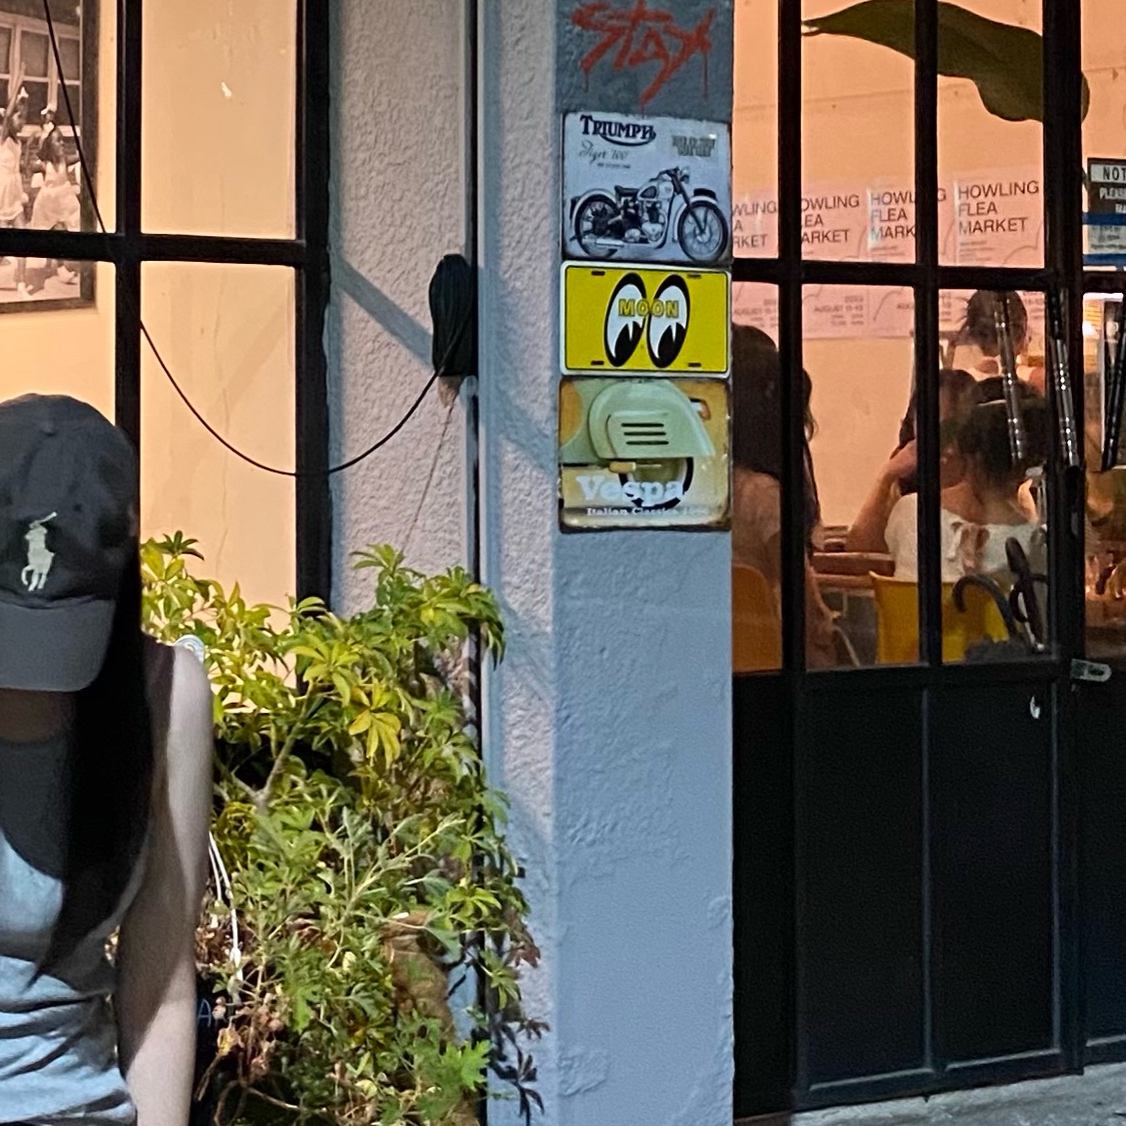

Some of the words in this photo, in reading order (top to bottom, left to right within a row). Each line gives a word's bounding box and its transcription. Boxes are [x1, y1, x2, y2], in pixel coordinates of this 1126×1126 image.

[580, 114, 657, 143] TRIUMPH
[958, 180, 1039, 200] HOWLING
[870, 208, 908, 223] FLEA
[958, 201, 998, 217] FLEA
[958, 217, 1028, 236] MARKET
[618, 298, 679, 319] MOON
[576, 475, 685, 507] Vespa
[587, 507, 629, 516] Italian
